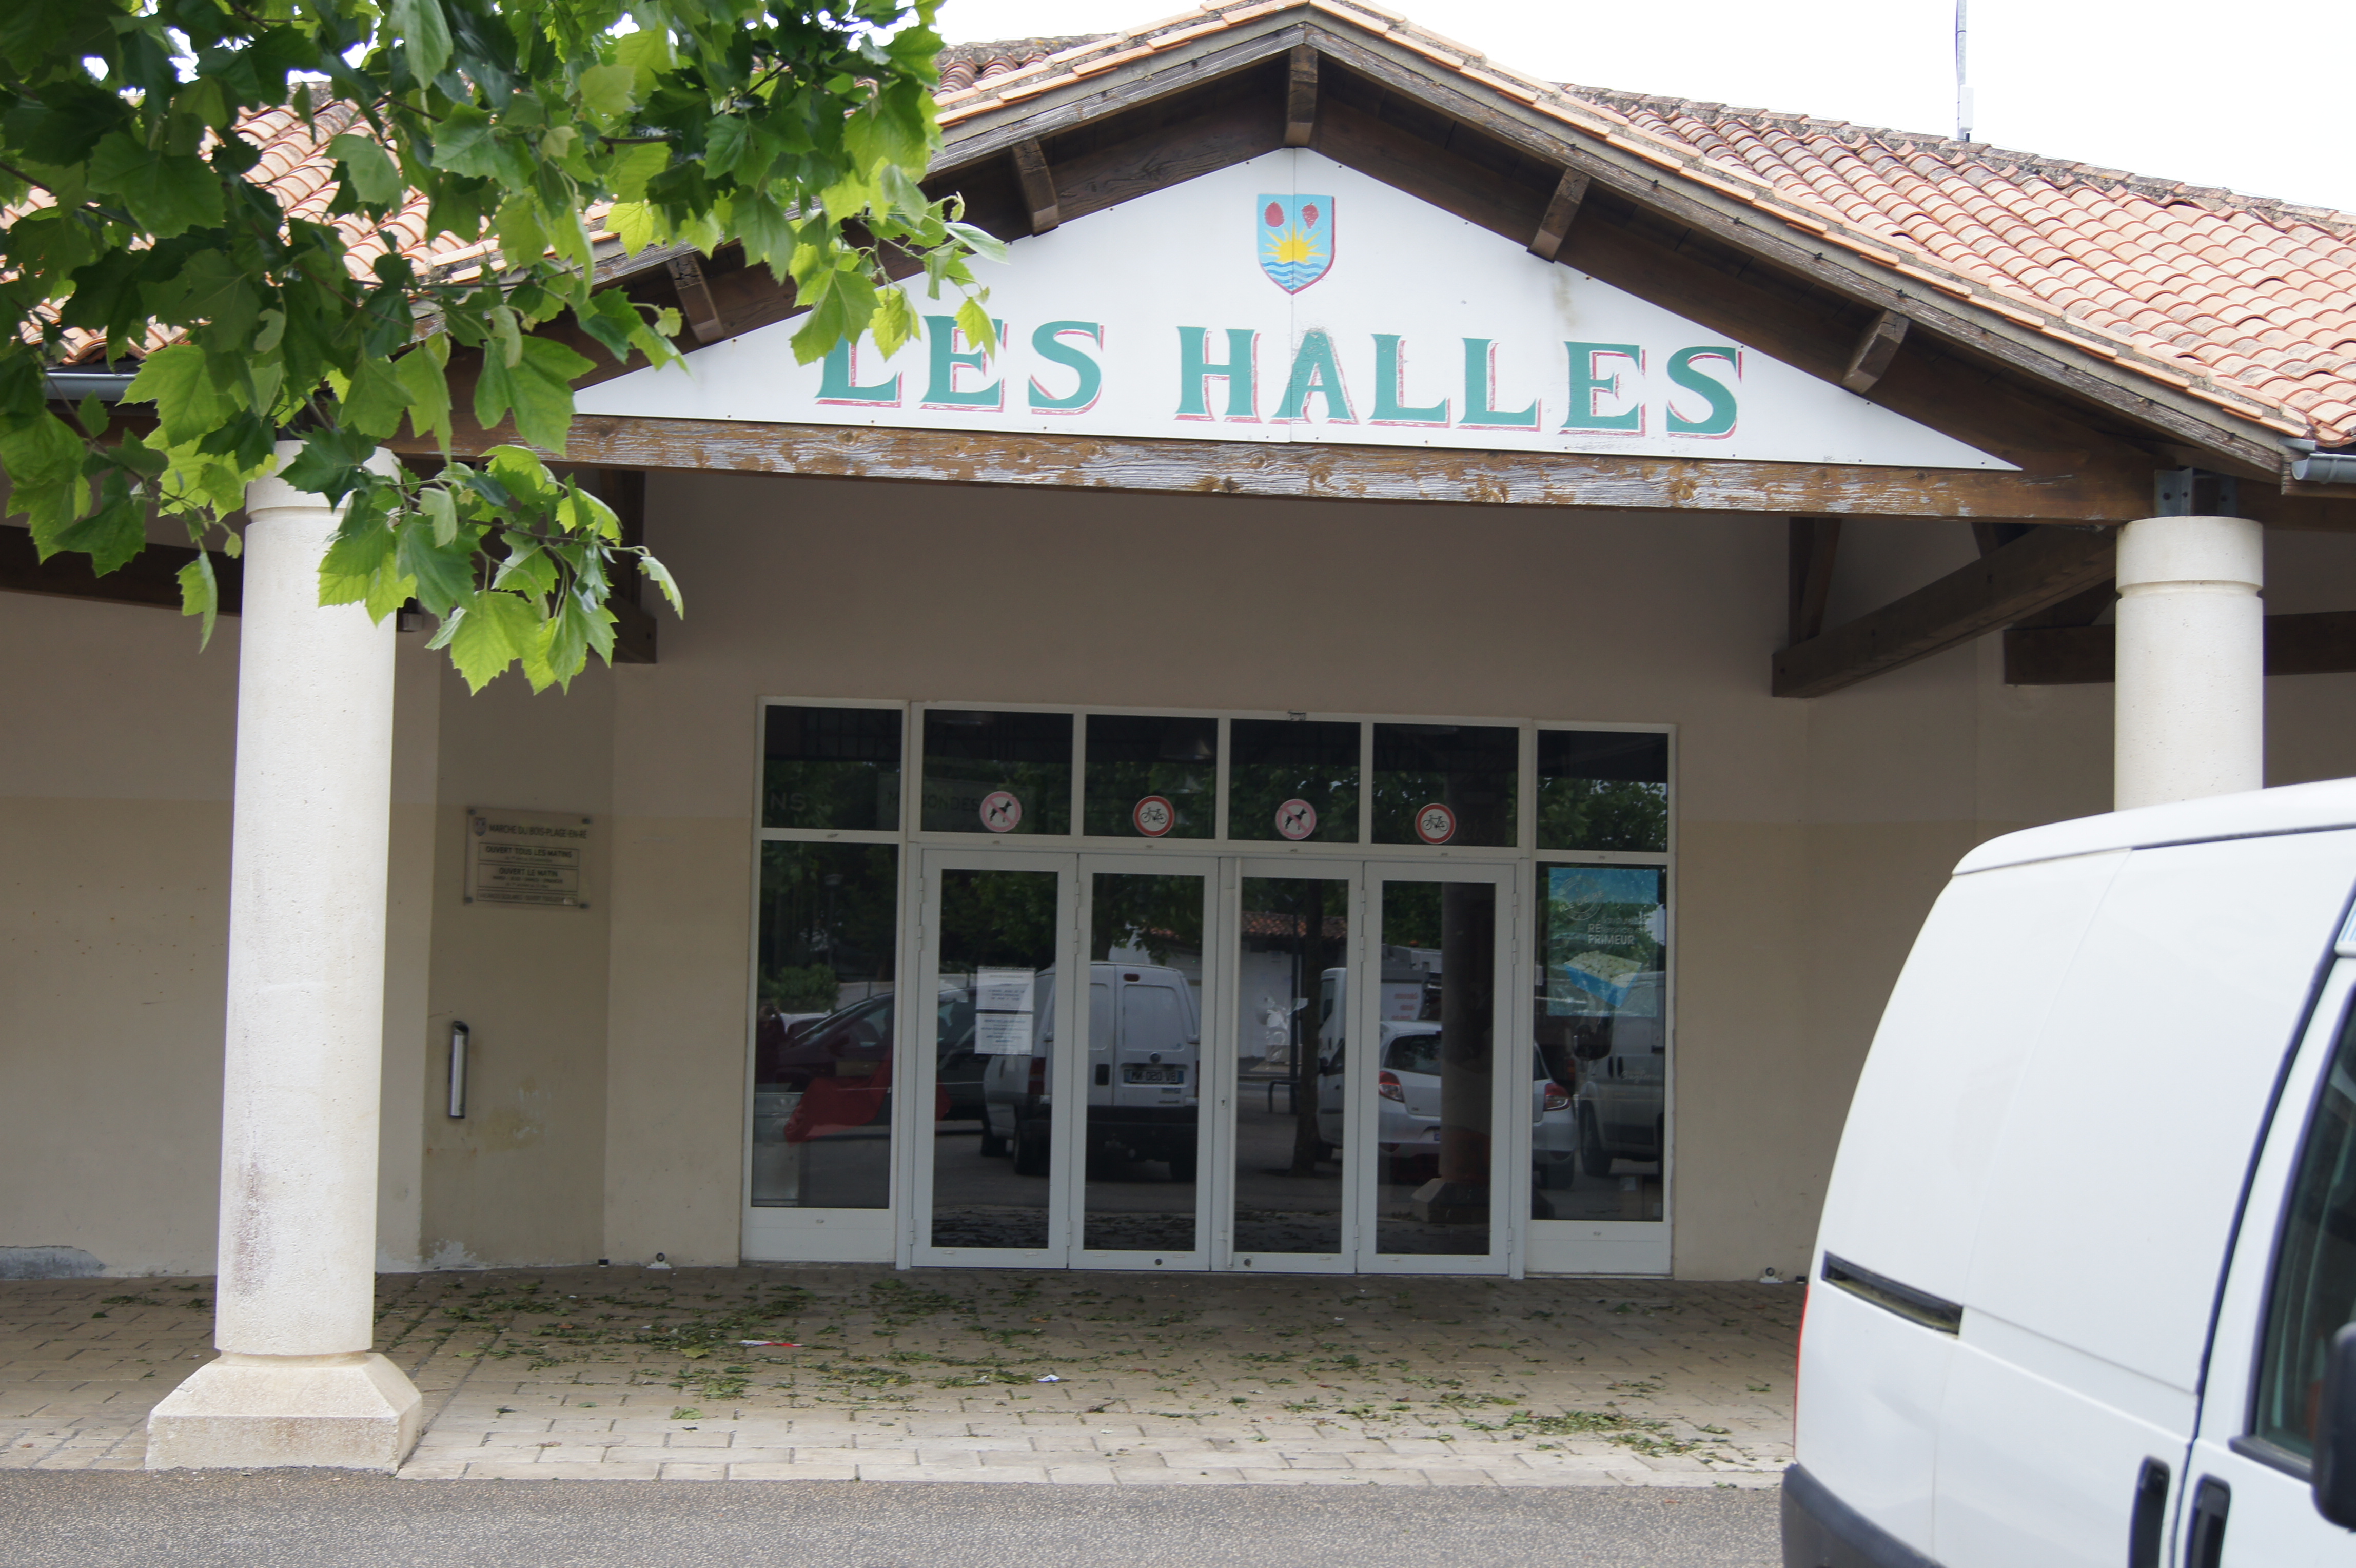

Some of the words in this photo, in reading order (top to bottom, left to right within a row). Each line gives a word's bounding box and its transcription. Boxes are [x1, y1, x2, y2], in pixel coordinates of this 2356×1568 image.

[814, 315, 1104, 415] LES
[1173, 325, 1743, 440] HALLES
[486, 846, 512, 854] OUVERT
[515, 847, 532, 855] TOUS
[534, 848, 546, 856] LES
[547, 849, 572, 858] MATINS
[499, 867, 525, 875] OUVERT
[1587, 934, 1635, 945] PRIMEUR
